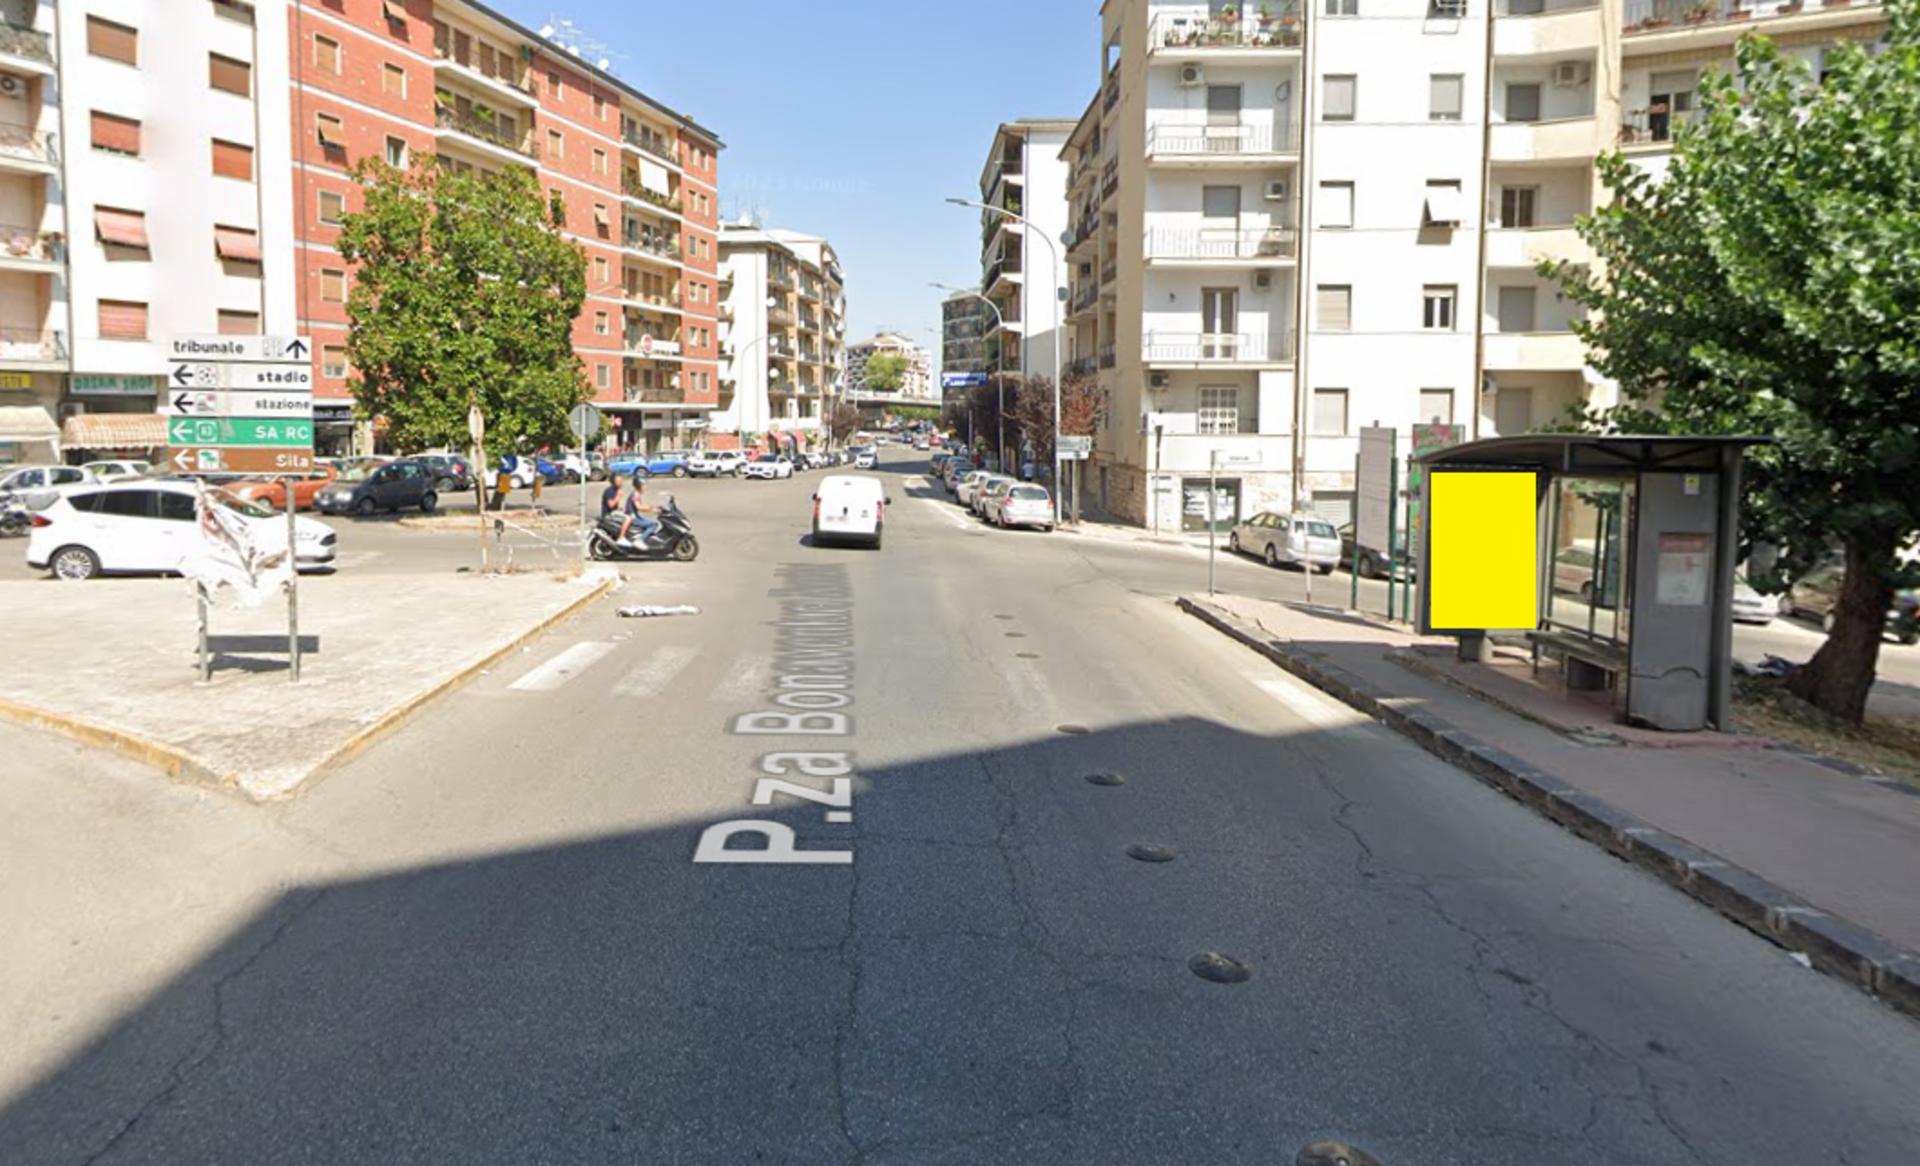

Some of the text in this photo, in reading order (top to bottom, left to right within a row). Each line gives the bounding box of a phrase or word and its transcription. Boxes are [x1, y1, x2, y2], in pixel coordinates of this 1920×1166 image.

[173, 341, 244, 354] tribunale
[257, 371, 308, 383] stadio
[255, 399, 310, 410] stazione
[275, 453, 309, 468] Sila
